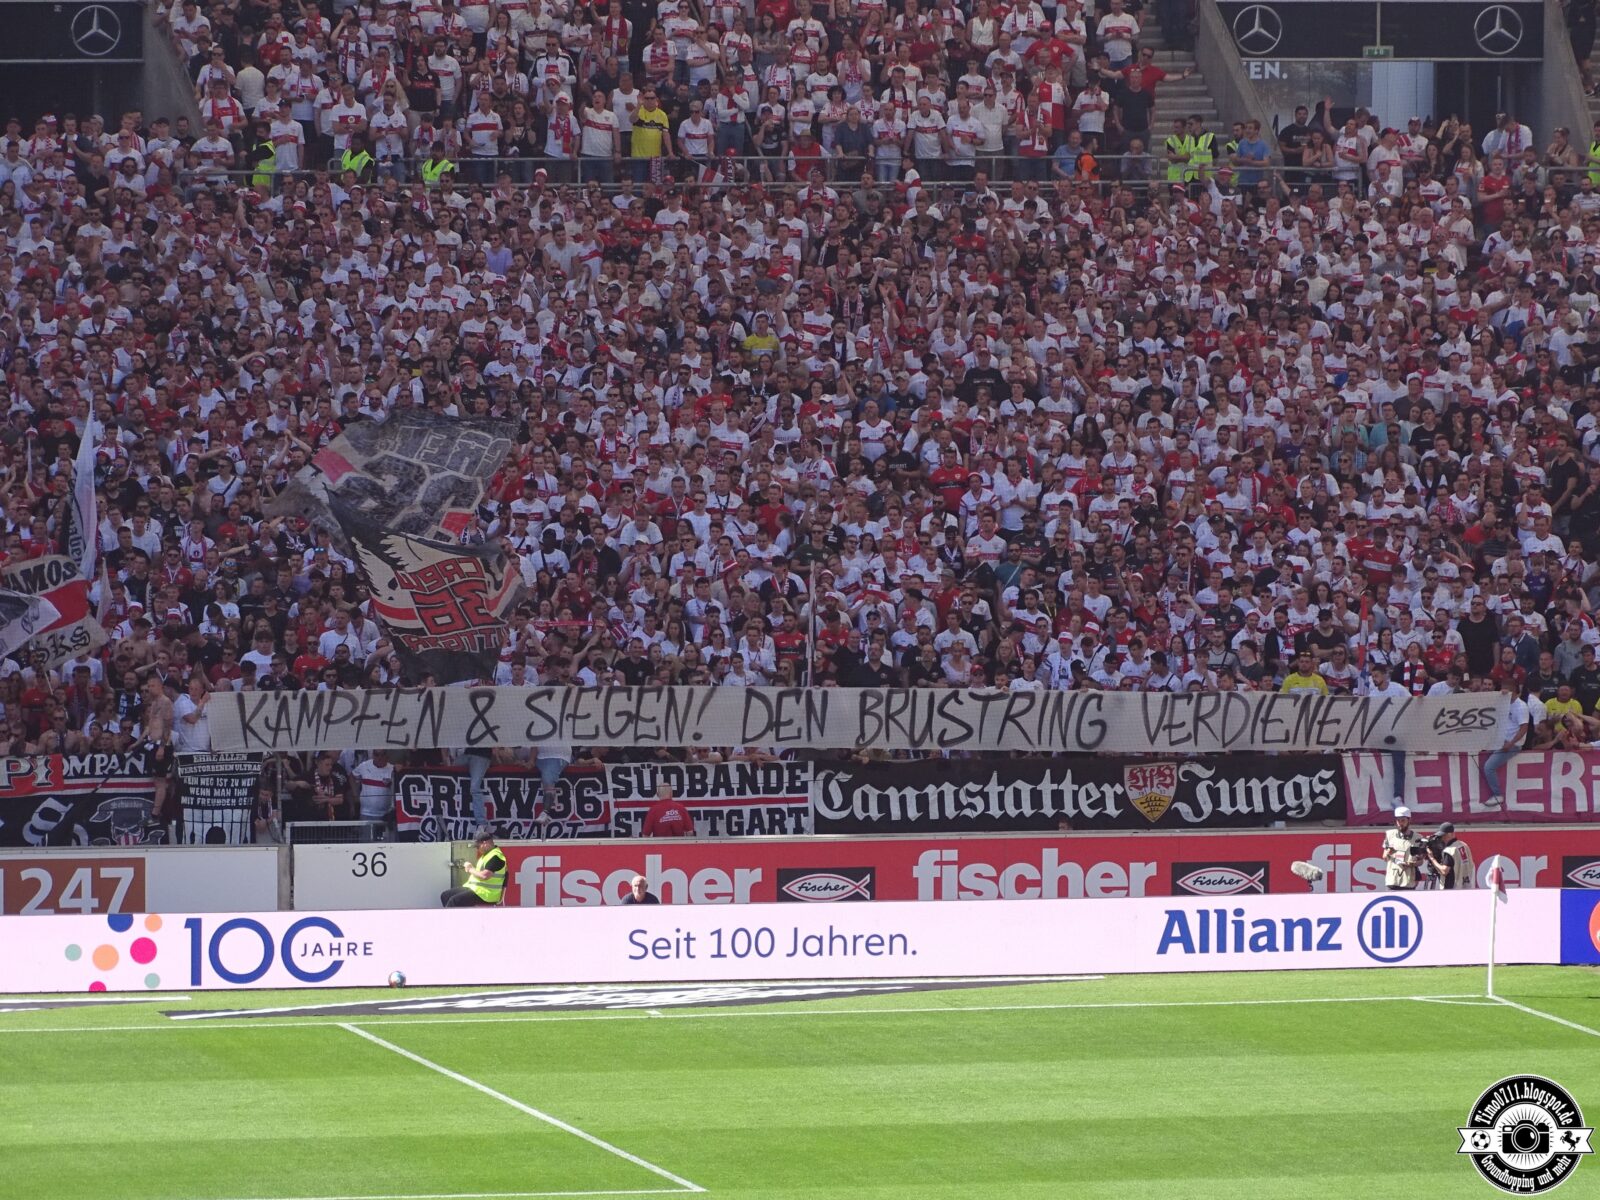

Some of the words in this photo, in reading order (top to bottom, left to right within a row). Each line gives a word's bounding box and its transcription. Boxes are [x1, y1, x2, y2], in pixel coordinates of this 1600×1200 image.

[236, 688, 446, 749] KÄMPFEN
[466, 687, 500, 746] &
[525, 686, 717, 744] SIEGEN!
[741, 688, 829, 745] DEN
[855, 689, 1107, 749] BRUSTRING
[1141, 692, 1413, 749] VERDIENEN!
[611, 763, 809, 799] SÜDBANDE
[814, 769, 1124, 822] Cannstatter
[1171, 762, 1337, 822] Jungs
[614, 807, 809, 838] STTTGART
[352, 852, 388, 878] 36
[515, 854, 763, 905] fischer
[913, 848, 1157, 900] fischer
[1192, 874, 1244, 887] fischer
[1302, 843, 1548, 893] fiser
[797, 880, 849, 893] fischer
[184, 916, 345, 986] 100
[300, 942, 374, 957] JAHRE
[628, 928, 697, 960] Seit
[709, 927, 775, 959] 100
[786, 925, 918, 957] Jahren.
[1157, 907, 1343, 955] Allianz
